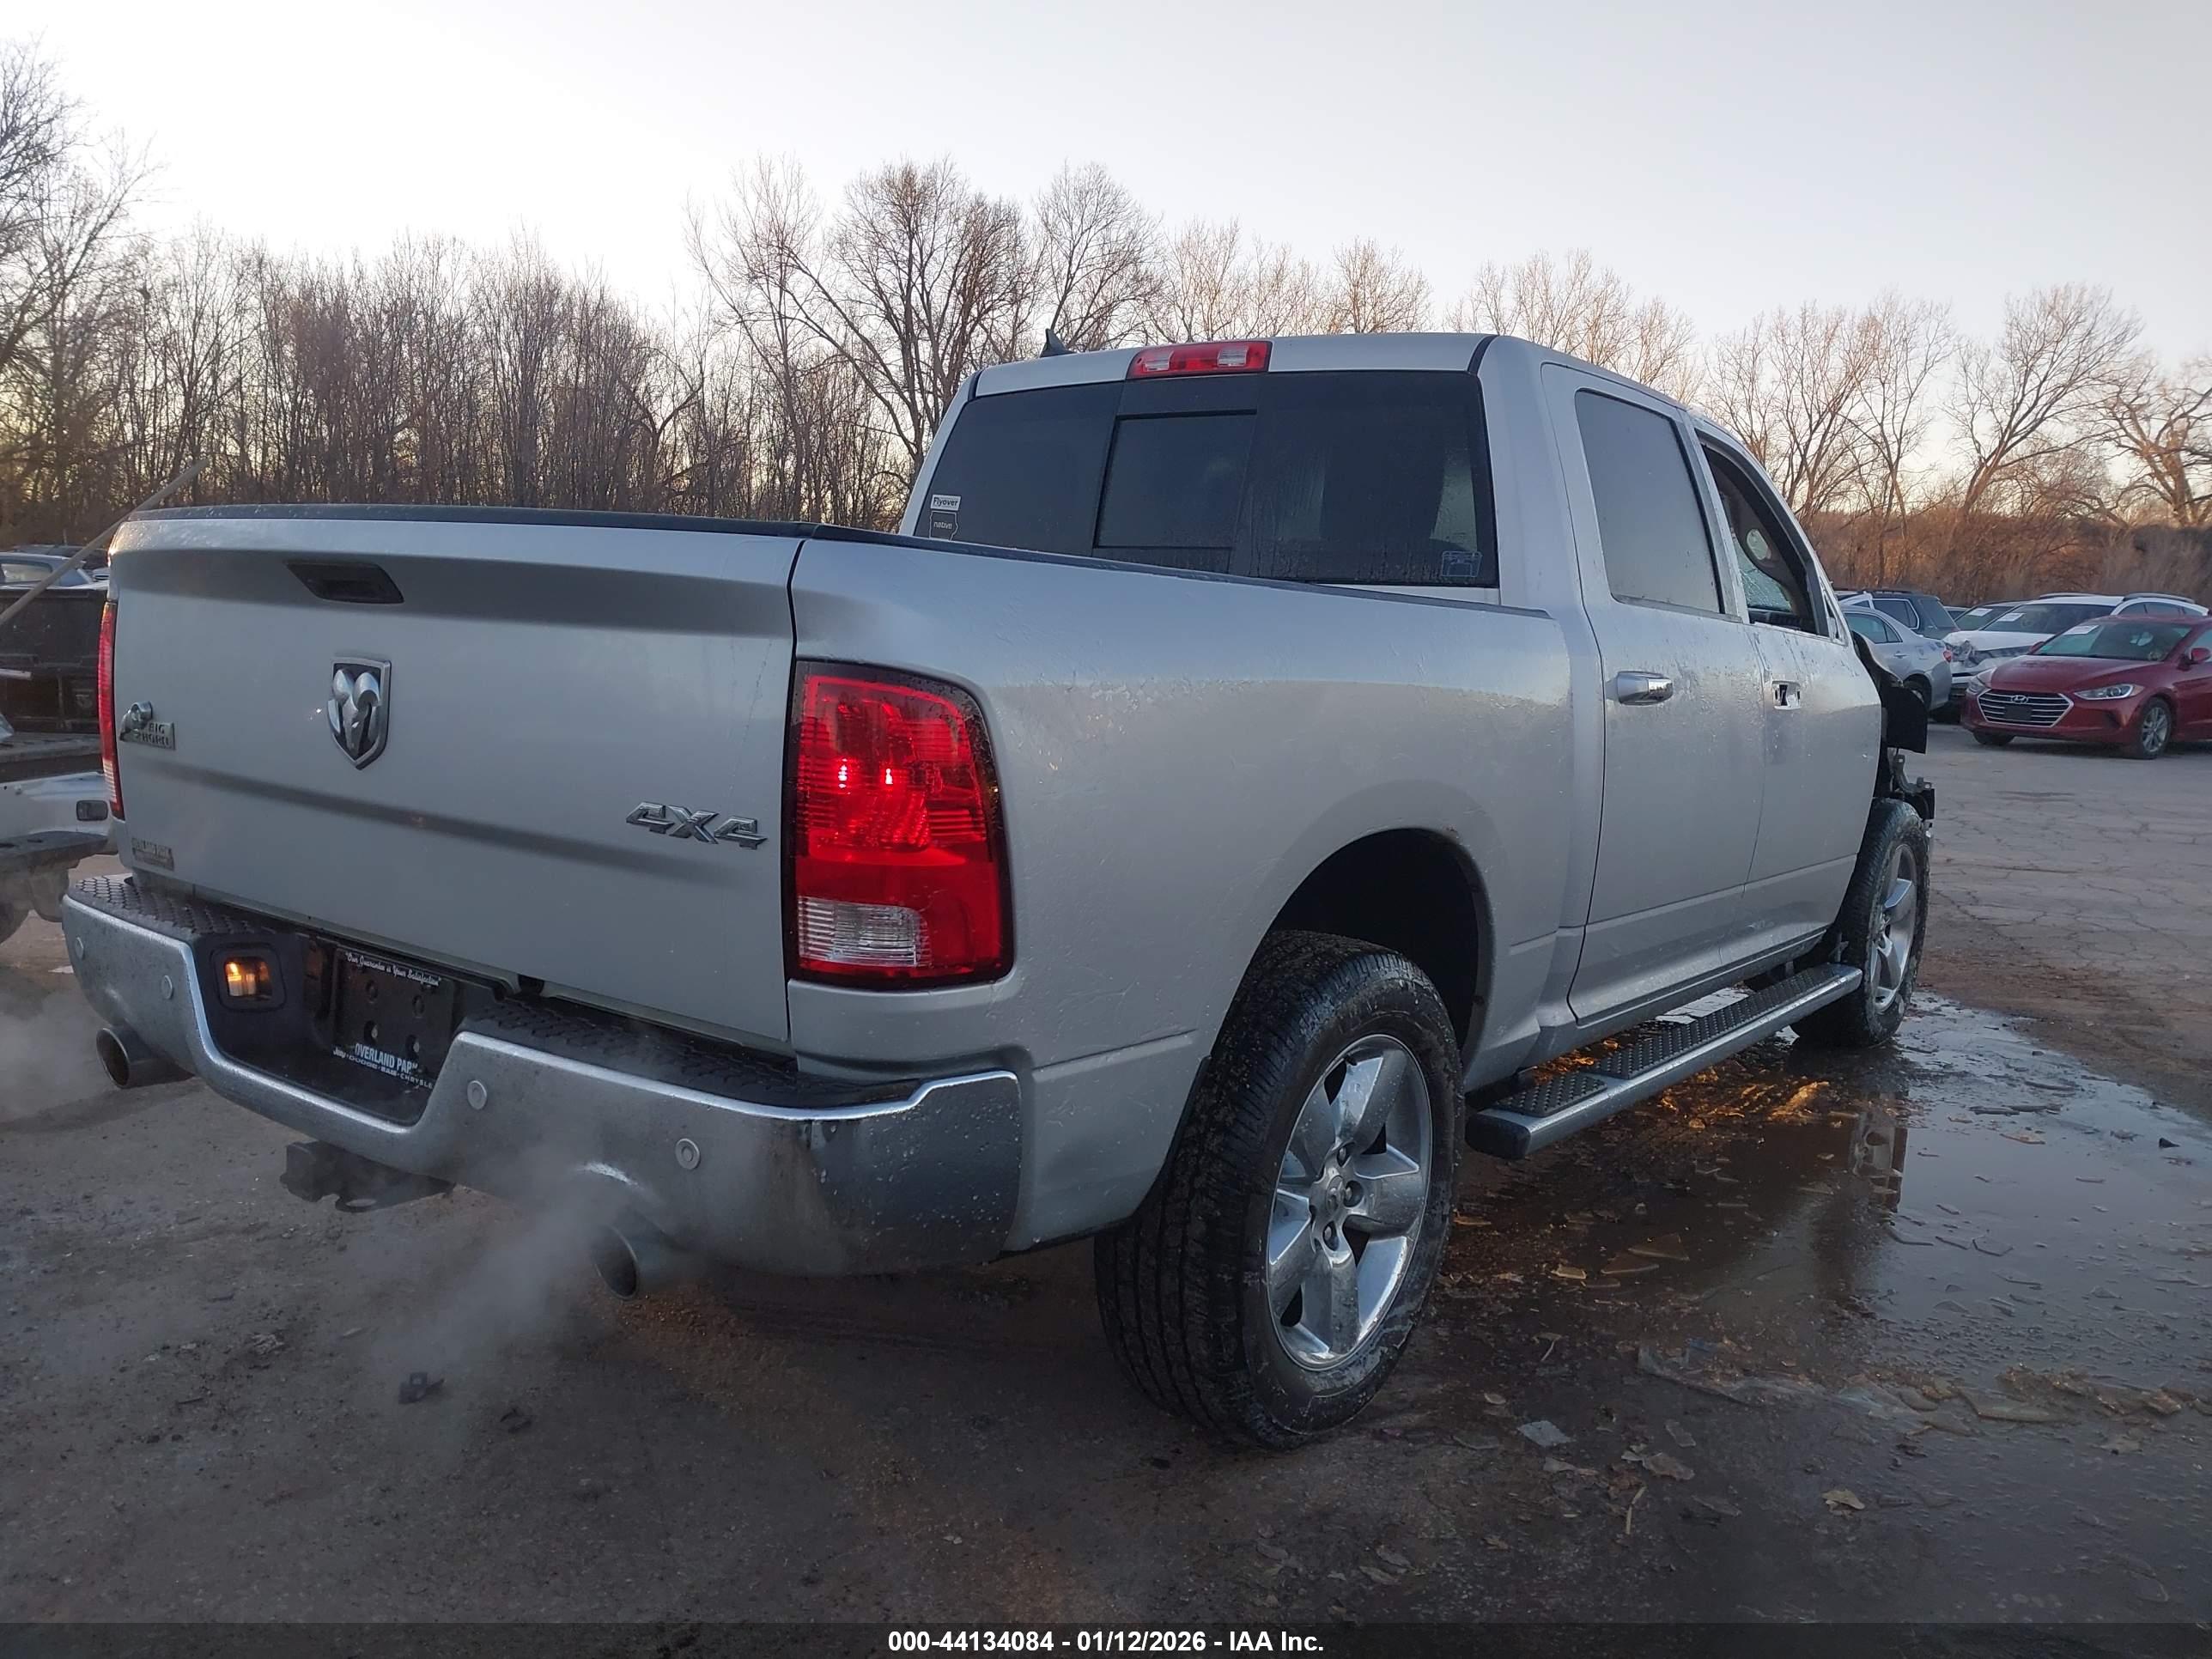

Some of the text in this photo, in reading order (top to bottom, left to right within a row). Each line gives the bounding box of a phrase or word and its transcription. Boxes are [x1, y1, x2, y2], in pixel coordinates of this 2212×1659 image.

[933, 496, 958, 507] Flyover
[933, 521, 953, 530] native
[355, 1043, 395, 1069] OVERLAND
